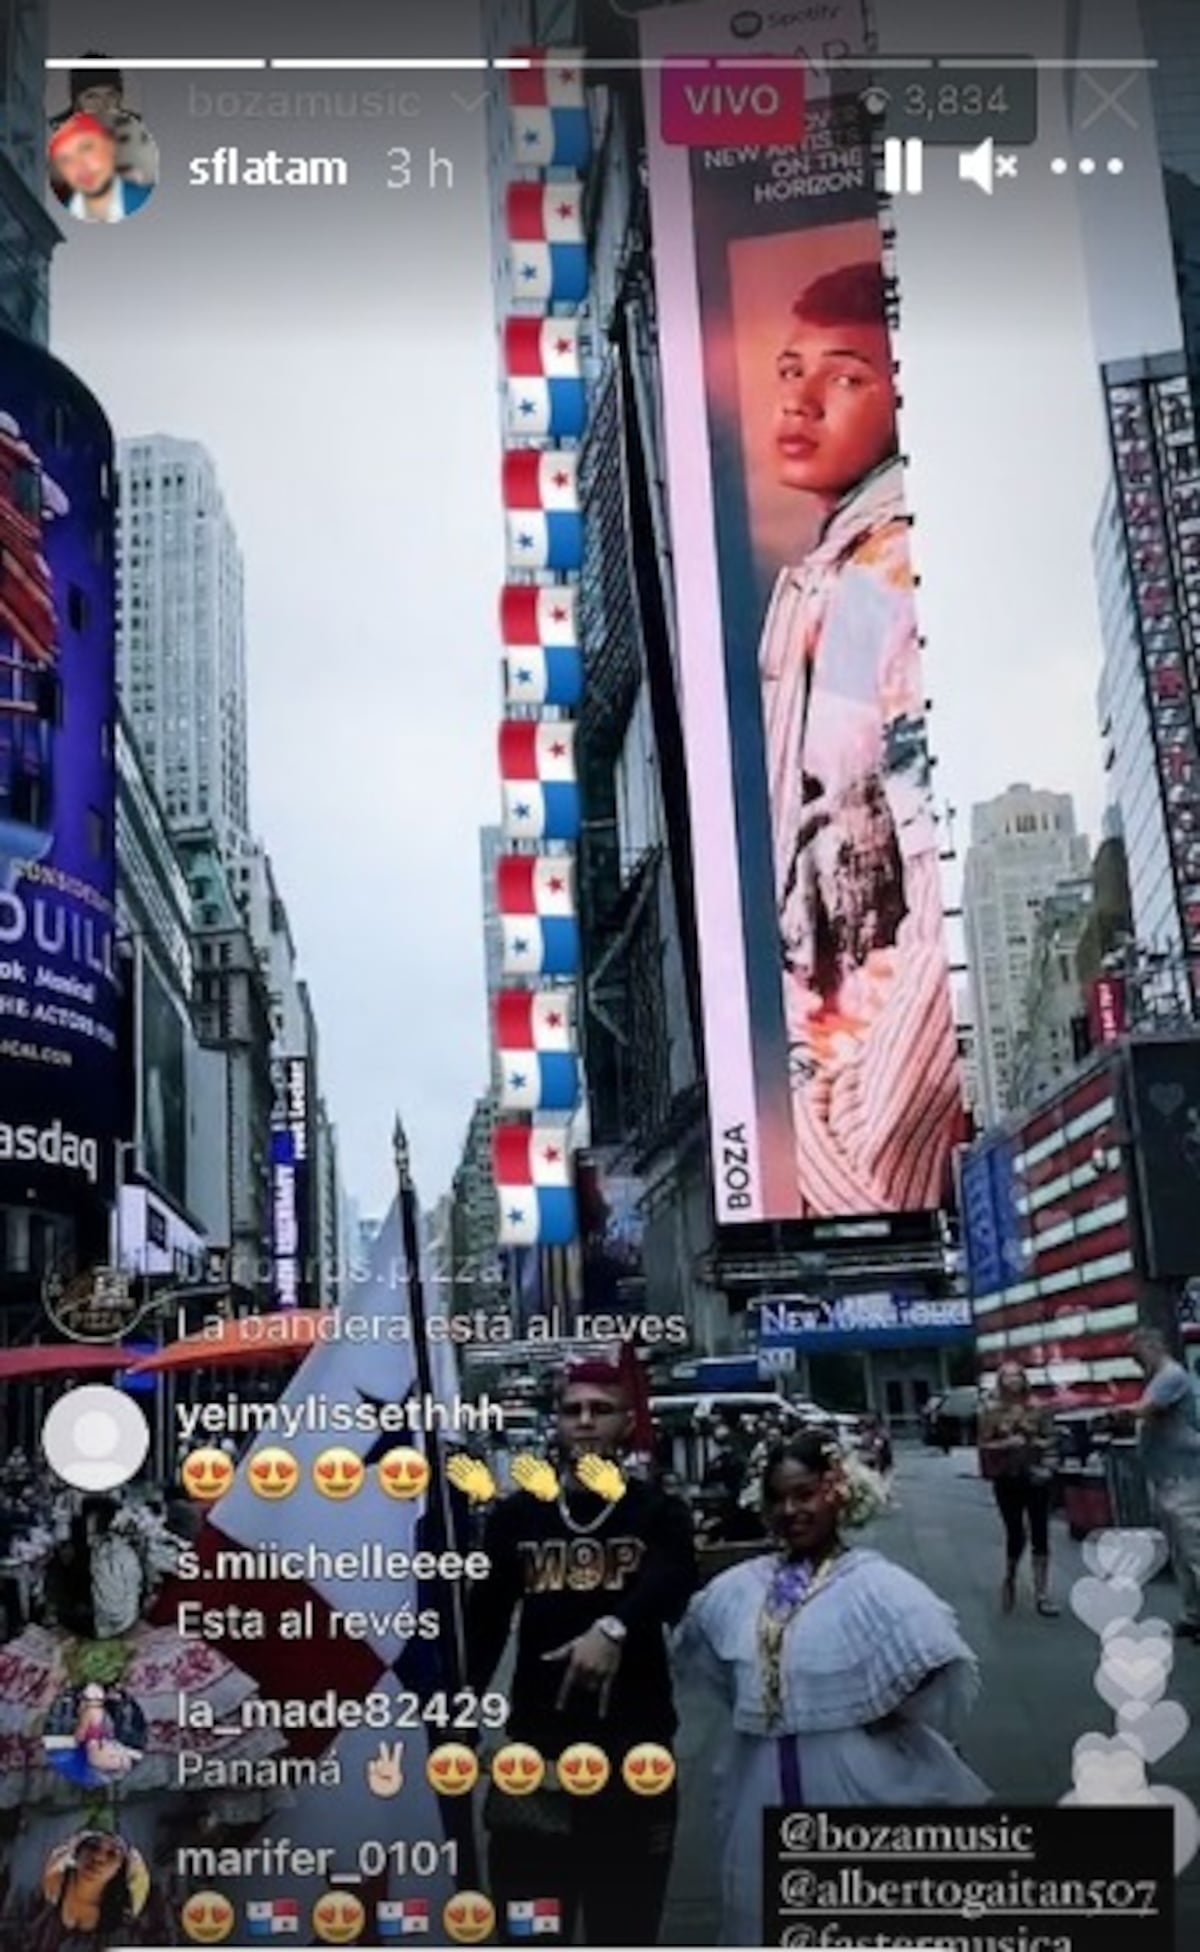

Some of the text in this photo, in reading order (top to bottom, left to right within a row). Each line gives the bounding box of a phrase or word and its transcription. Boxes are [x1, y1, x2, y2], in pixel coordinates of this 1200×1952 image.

[767, 3, 842, 28] Spotify
[704, 144, 760, 169] NEW
[770, 147, 863, 178] ON THE
[753, 168, 865, 204] HORIZON
[0, 1118, 97, 1183] asdaq
[724, 1123, 752, 1211] BOZA
